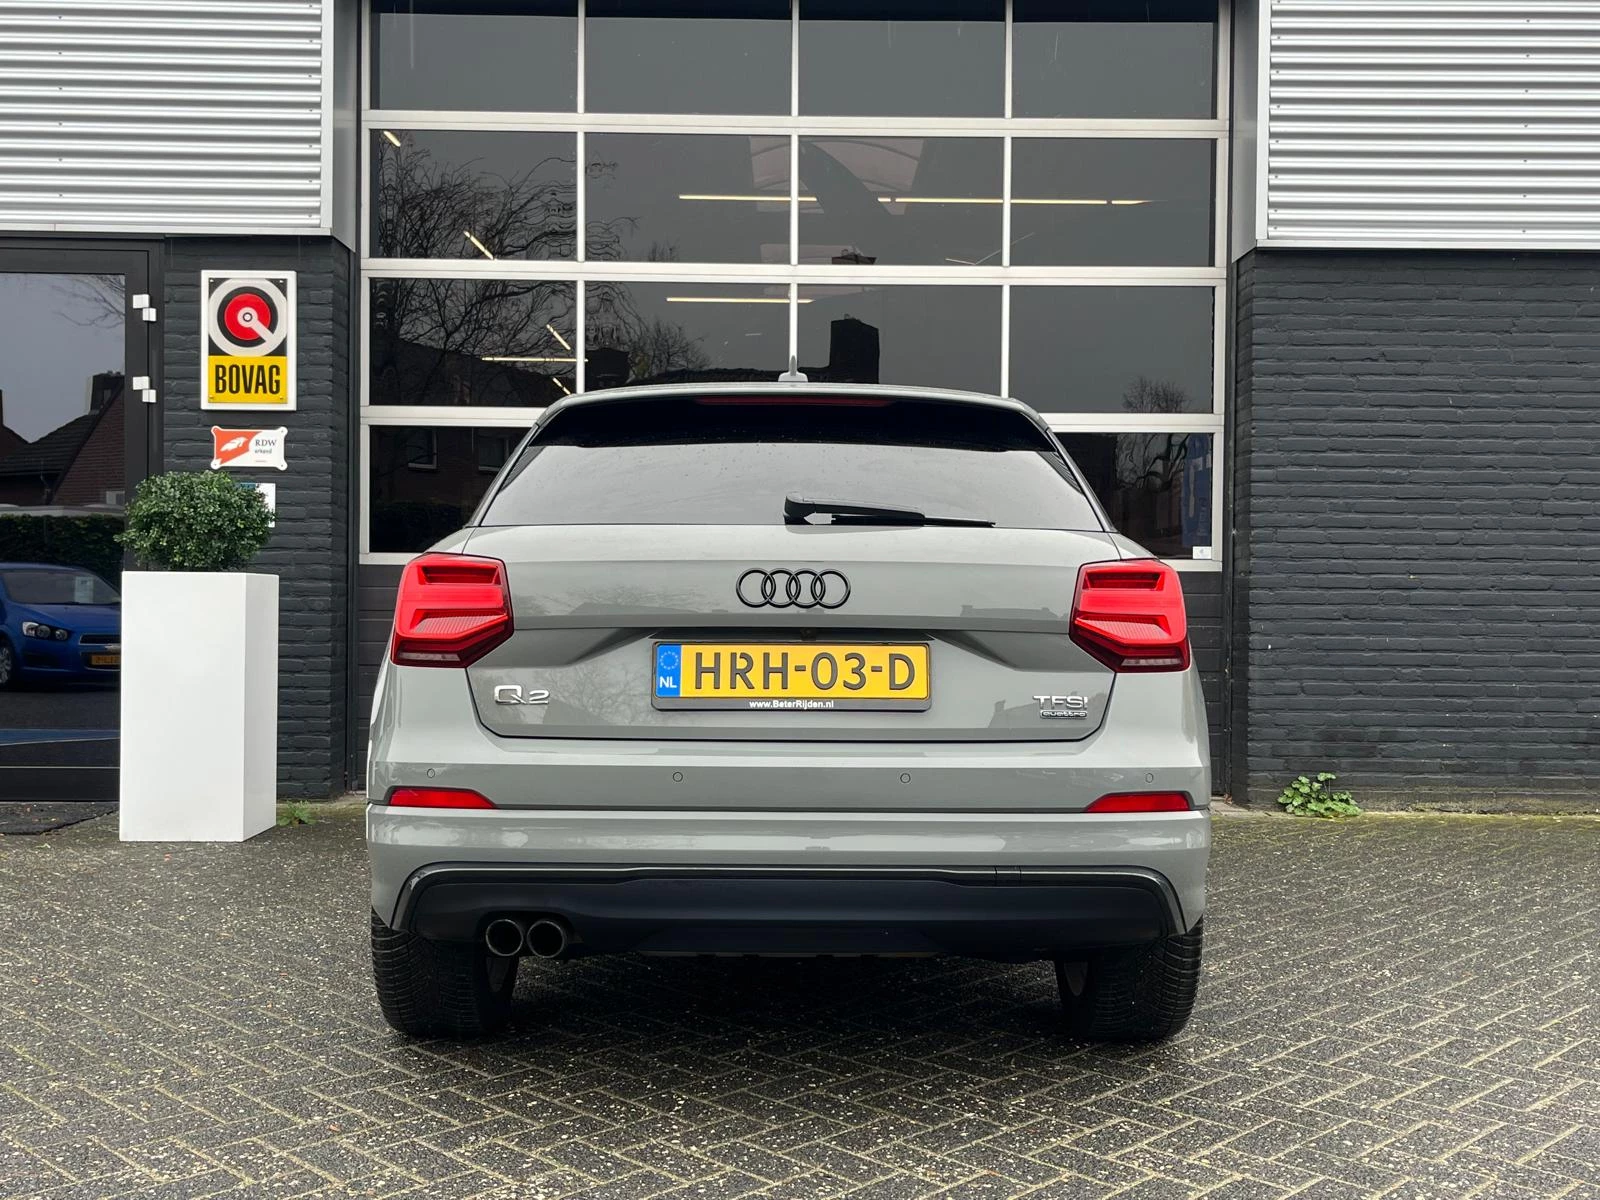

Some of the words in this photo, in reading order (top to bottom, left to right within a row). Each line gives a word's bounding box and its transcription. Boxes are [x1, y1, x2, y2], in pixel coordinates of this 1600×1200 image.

[215, 364, 281, 395] BOVAG
[255, 439, 277, 447] RDW
[695, 652, 916, 691] HRH-03-D
[659, 676, 677, 688] NL
[494, 685, 549, 705] Q2
[1033, 695, 1088, 709] TFSI
[749, 700, 834, 710] www.BeterRijden.nl
